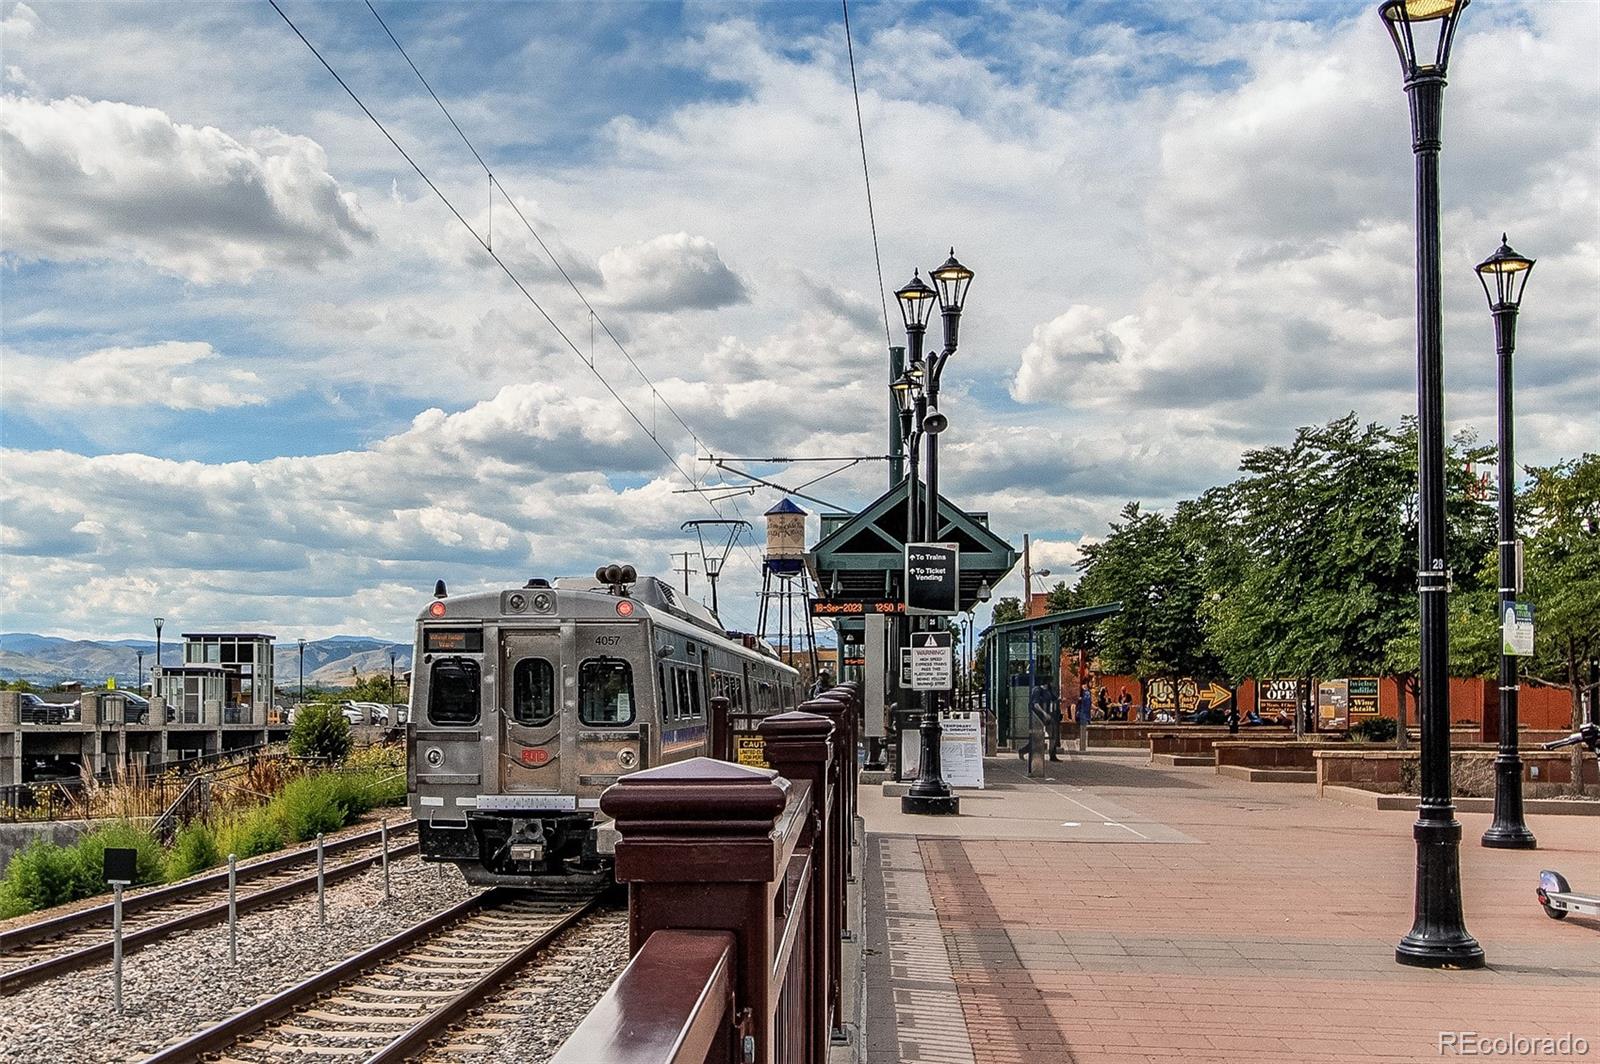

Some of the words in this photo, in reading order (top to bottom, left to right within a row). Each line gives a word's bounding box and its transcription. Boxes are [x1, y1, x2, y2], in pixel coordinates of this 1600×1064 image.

[1432, 558, 1444, 570] 28
[596, 636, 620, 646] 4057
[522, 750, 548, 762] RTD
